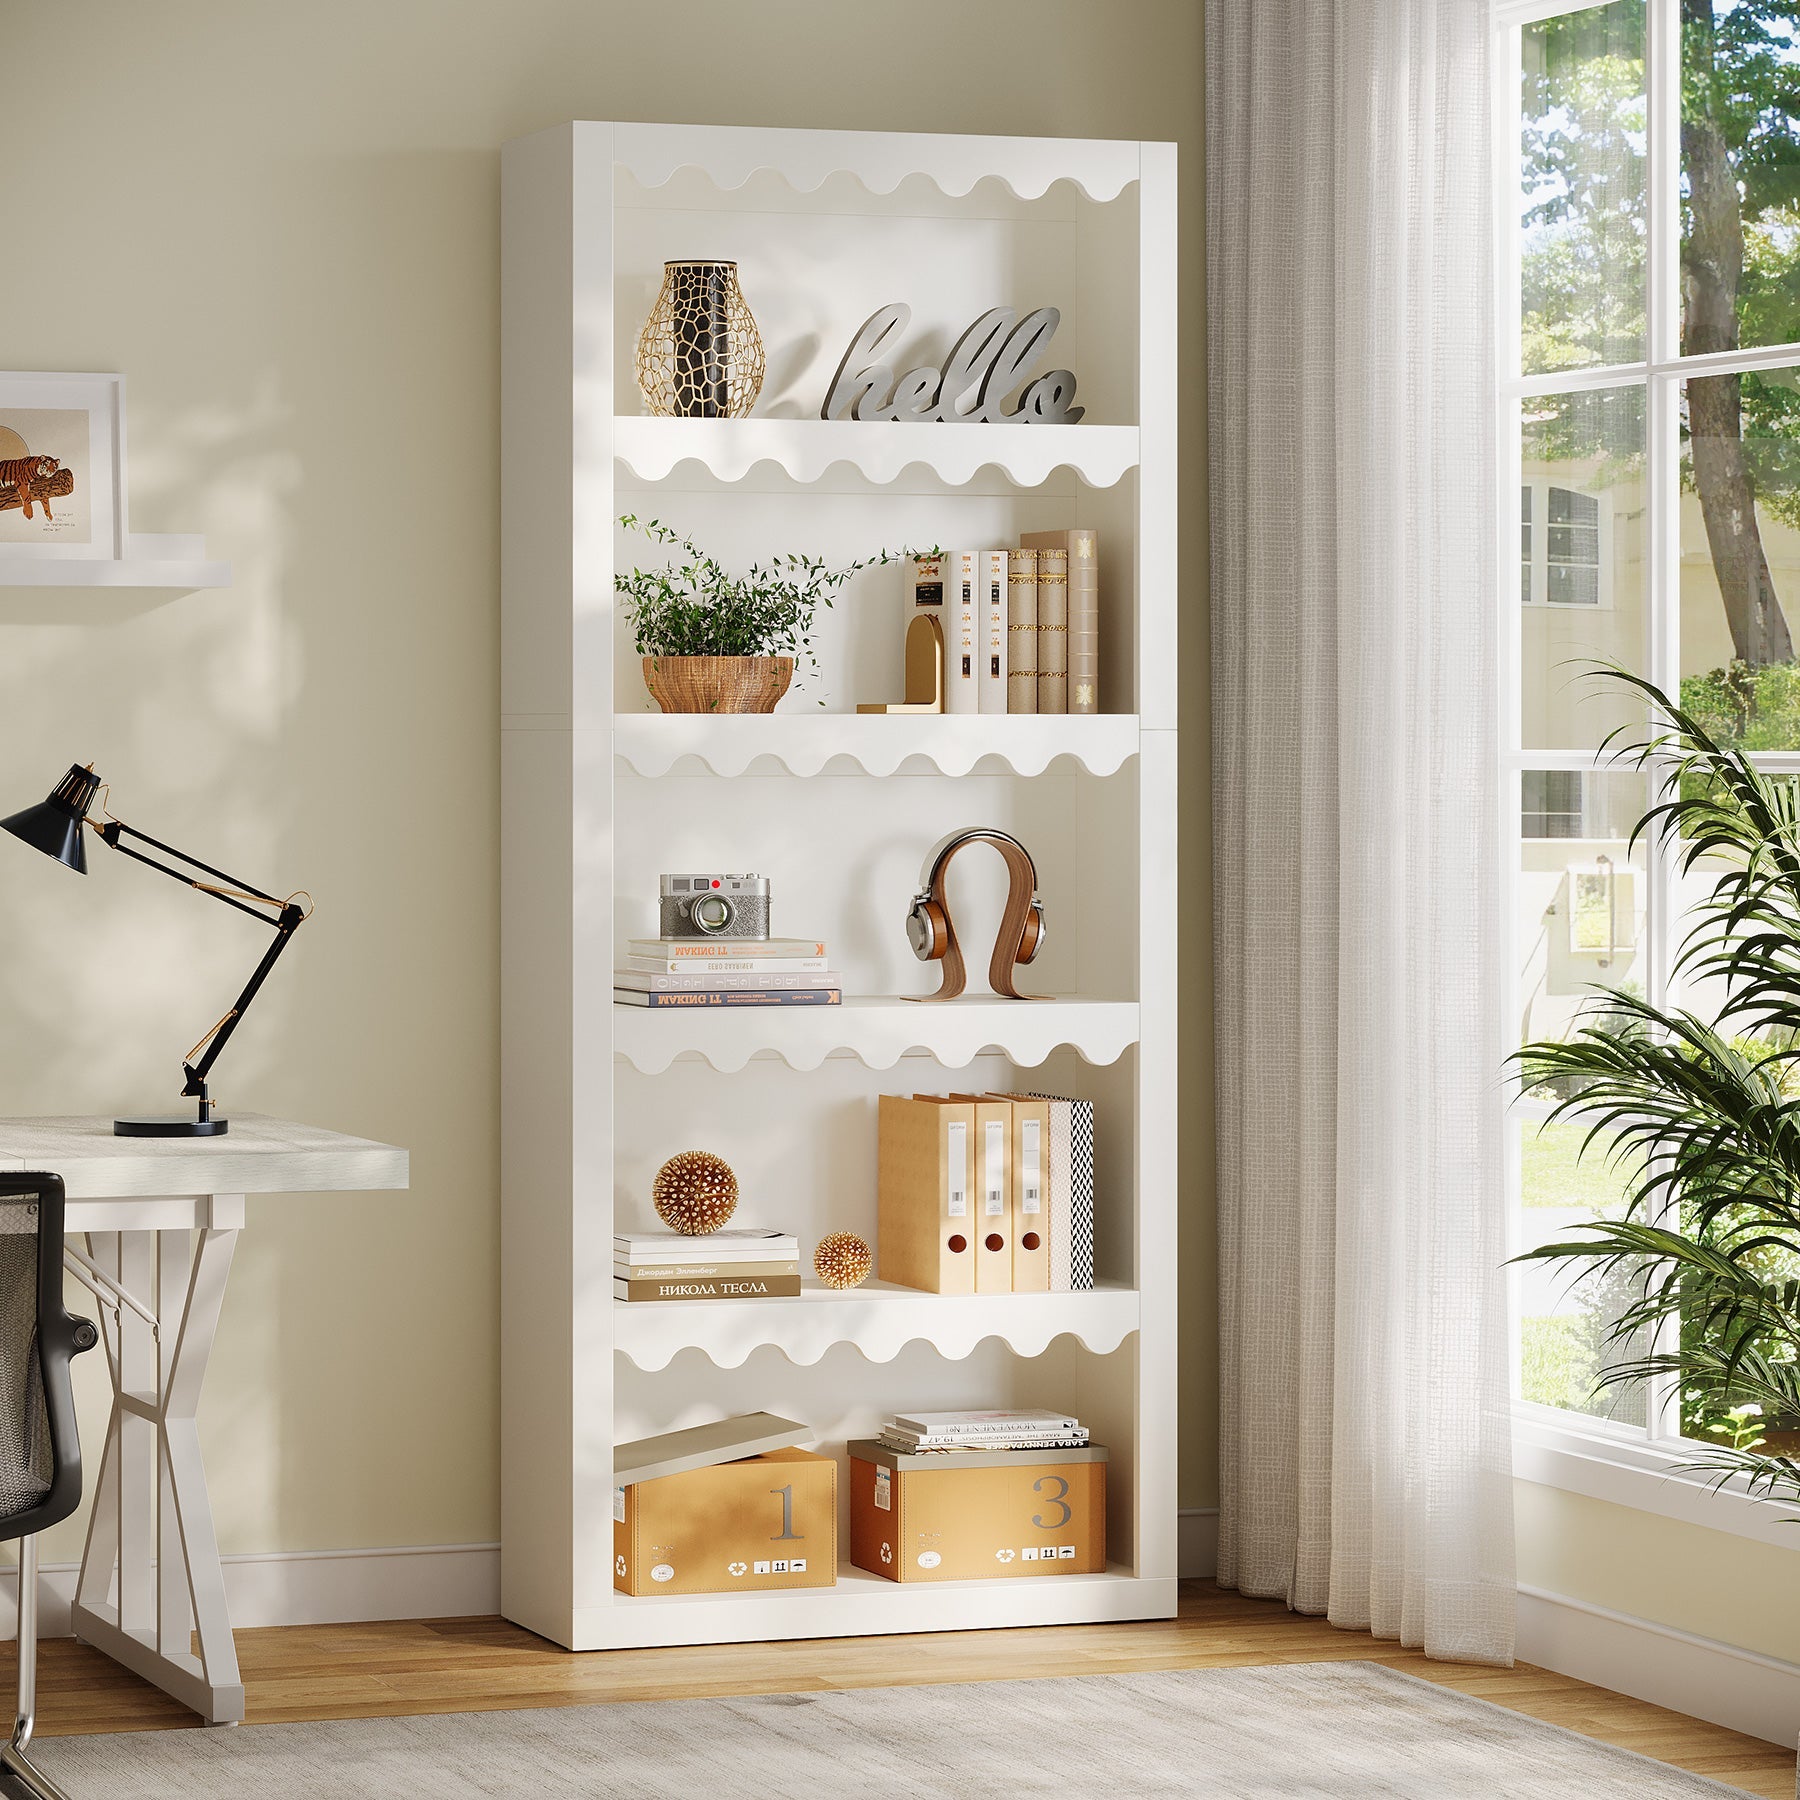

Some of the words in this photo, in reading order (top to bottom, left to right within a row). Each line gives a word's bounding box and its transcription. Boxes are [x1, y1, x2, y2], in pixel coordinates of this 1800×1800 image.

[820, 302, 1086, 424] hello
[637, 1268, 674, 1277] Джордан
[658, 1284, 717, 1296] НИКОЛА
[720, 1282, 768, 1294] ТЕСЛА
[1057, 1439, 1084, 1447] SARA
[769, 1484, 805, 1541] 1
[1031, 1475, 1072, 1530] 3
